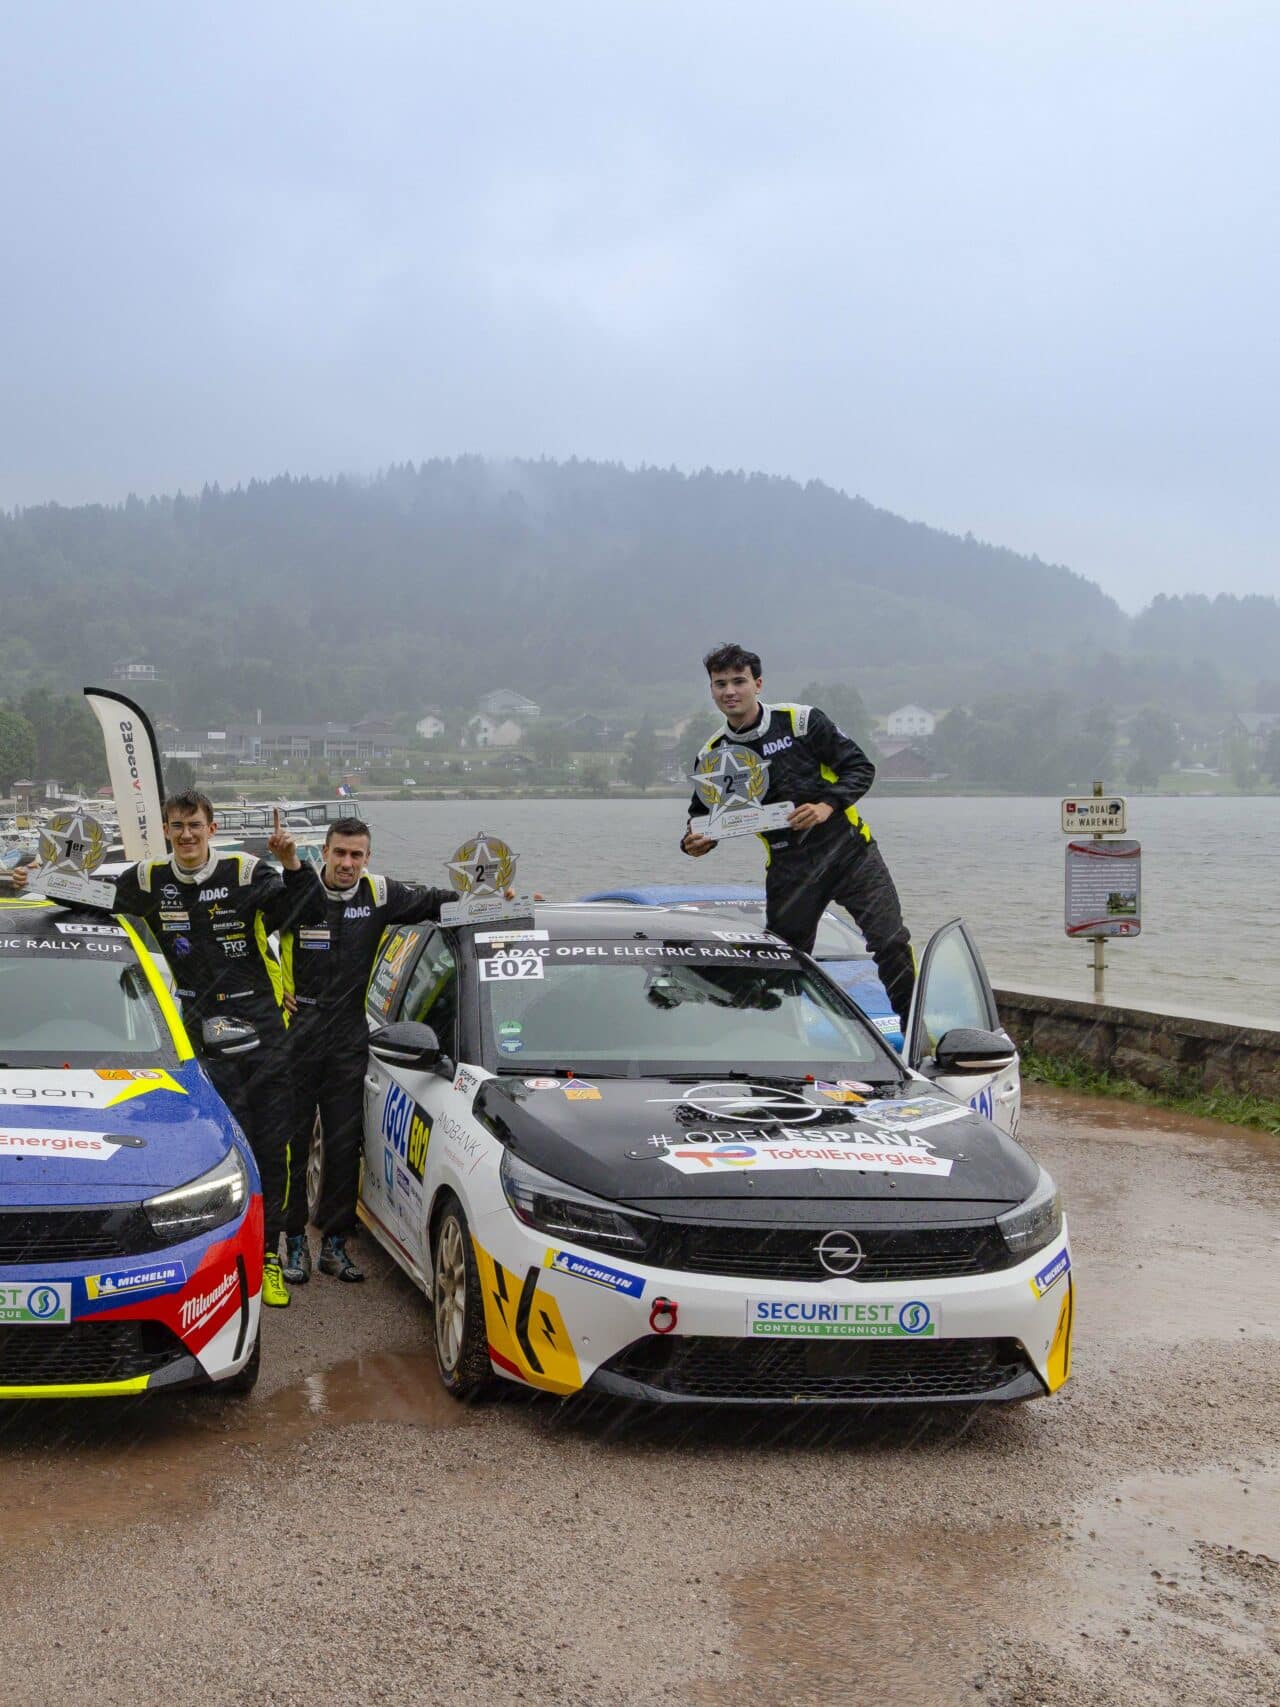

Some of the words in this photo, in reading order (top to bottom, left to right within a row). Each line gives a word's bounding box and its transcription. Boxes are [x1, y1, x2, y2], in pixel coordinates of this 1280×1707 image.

[762, 736, 793, 756] ADAC
[723, 775, 735, 793] 2
[476, 865, 485, 882] 2
[199, 887, 229, 902] ADAC
[344, 906, 370, 918] ADAC
[26, 941, 80, 951] RALLY
[86, 943, 122, 953] CUP
[223, 941, 246, 953] FKP
[493, 947, 550, 959] ADAC
[556, 947, 608, 956] OPEL
[614, 947, 696, 957] ELECTRIC
[701, 948, 751, 958] RALLY
[756, 950, 792, 961] CUP
[484, 960, 539, 978] E02
[382, 1081, 413, 1158] IGOL
[438, 1112, 481, 1156] ANDBANK
[409, 1115, 429, 1178] E02
[763, 1148, 936, 1166] TotalEnergies
[118, 1269, 175, 1288] MICHELIN
[570, 1262, 633, 1289] MICHELIN
[1044, 1257, 1069, 1289] MICHELIN
[178, 1269, 239, 1324] Milwaukee
[757, 1302, 894, 1321] SECURITEST
[756, 1324, 820, 1334] CONTROLE
[825, 1325, 894, 1335] TECHNIQUE
